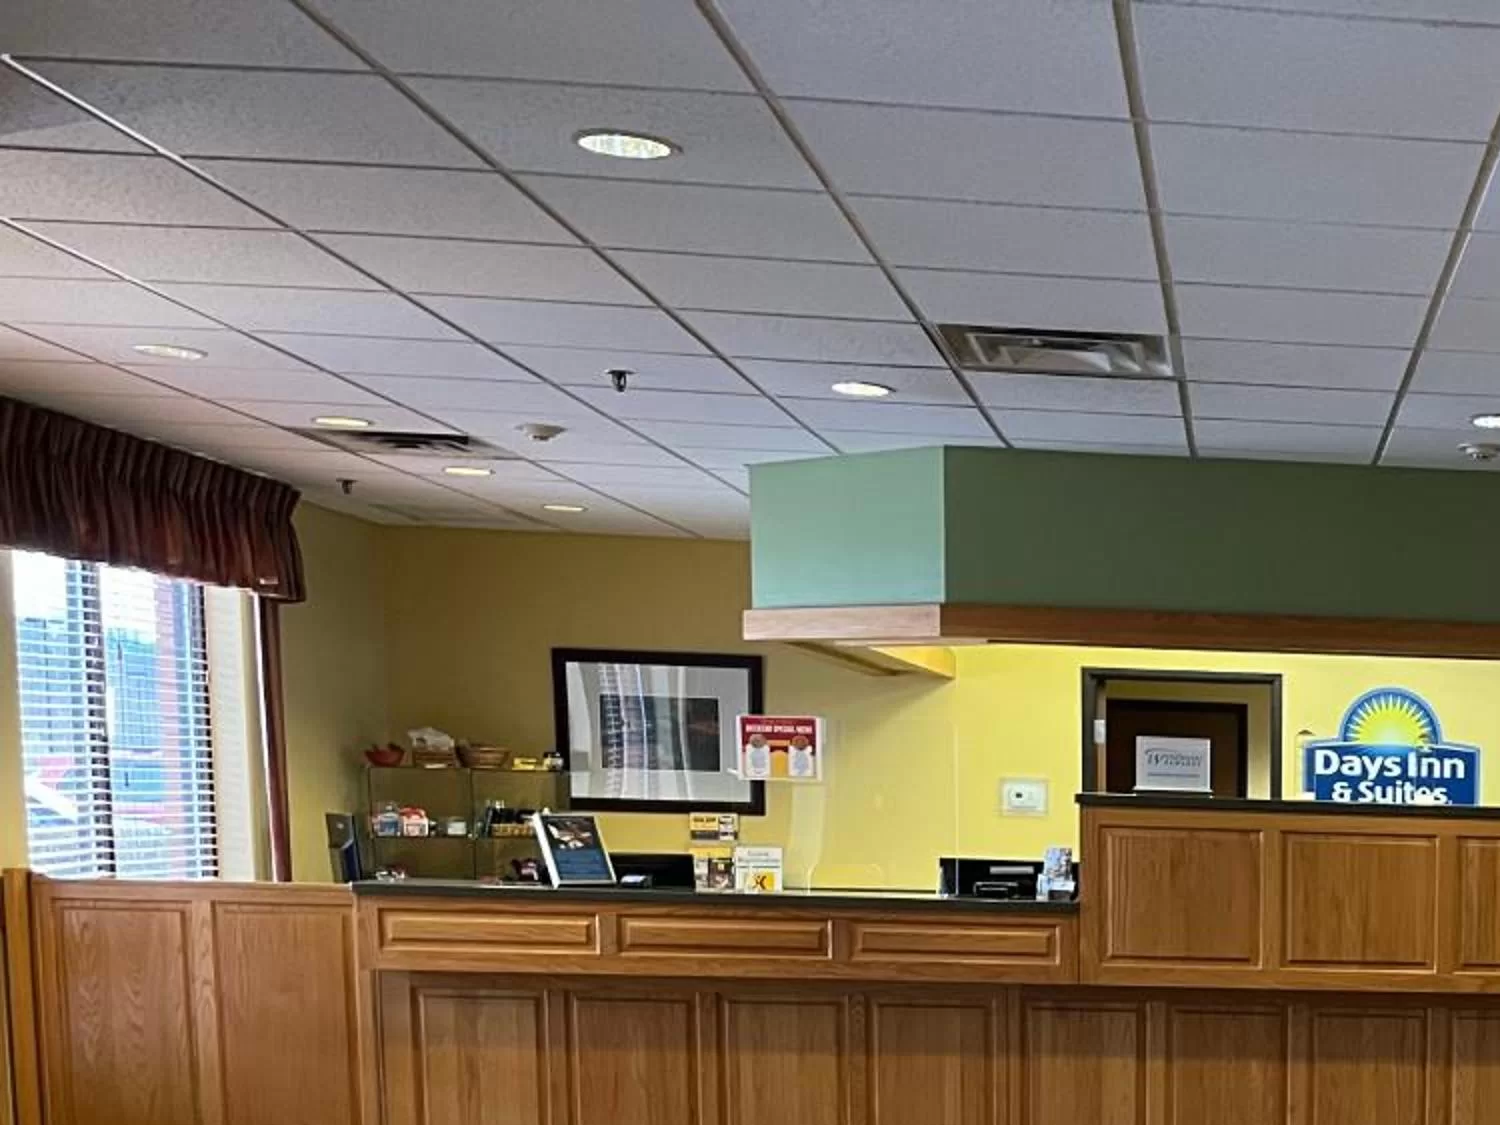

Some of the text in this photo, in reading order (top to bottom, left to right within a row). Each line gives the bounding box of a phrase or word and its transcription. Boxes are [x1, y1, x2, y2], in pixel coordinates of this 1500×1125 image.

[1314, 748, 1466, 780] Days Inn
[1331, 780, 1449, 805] & Suites
